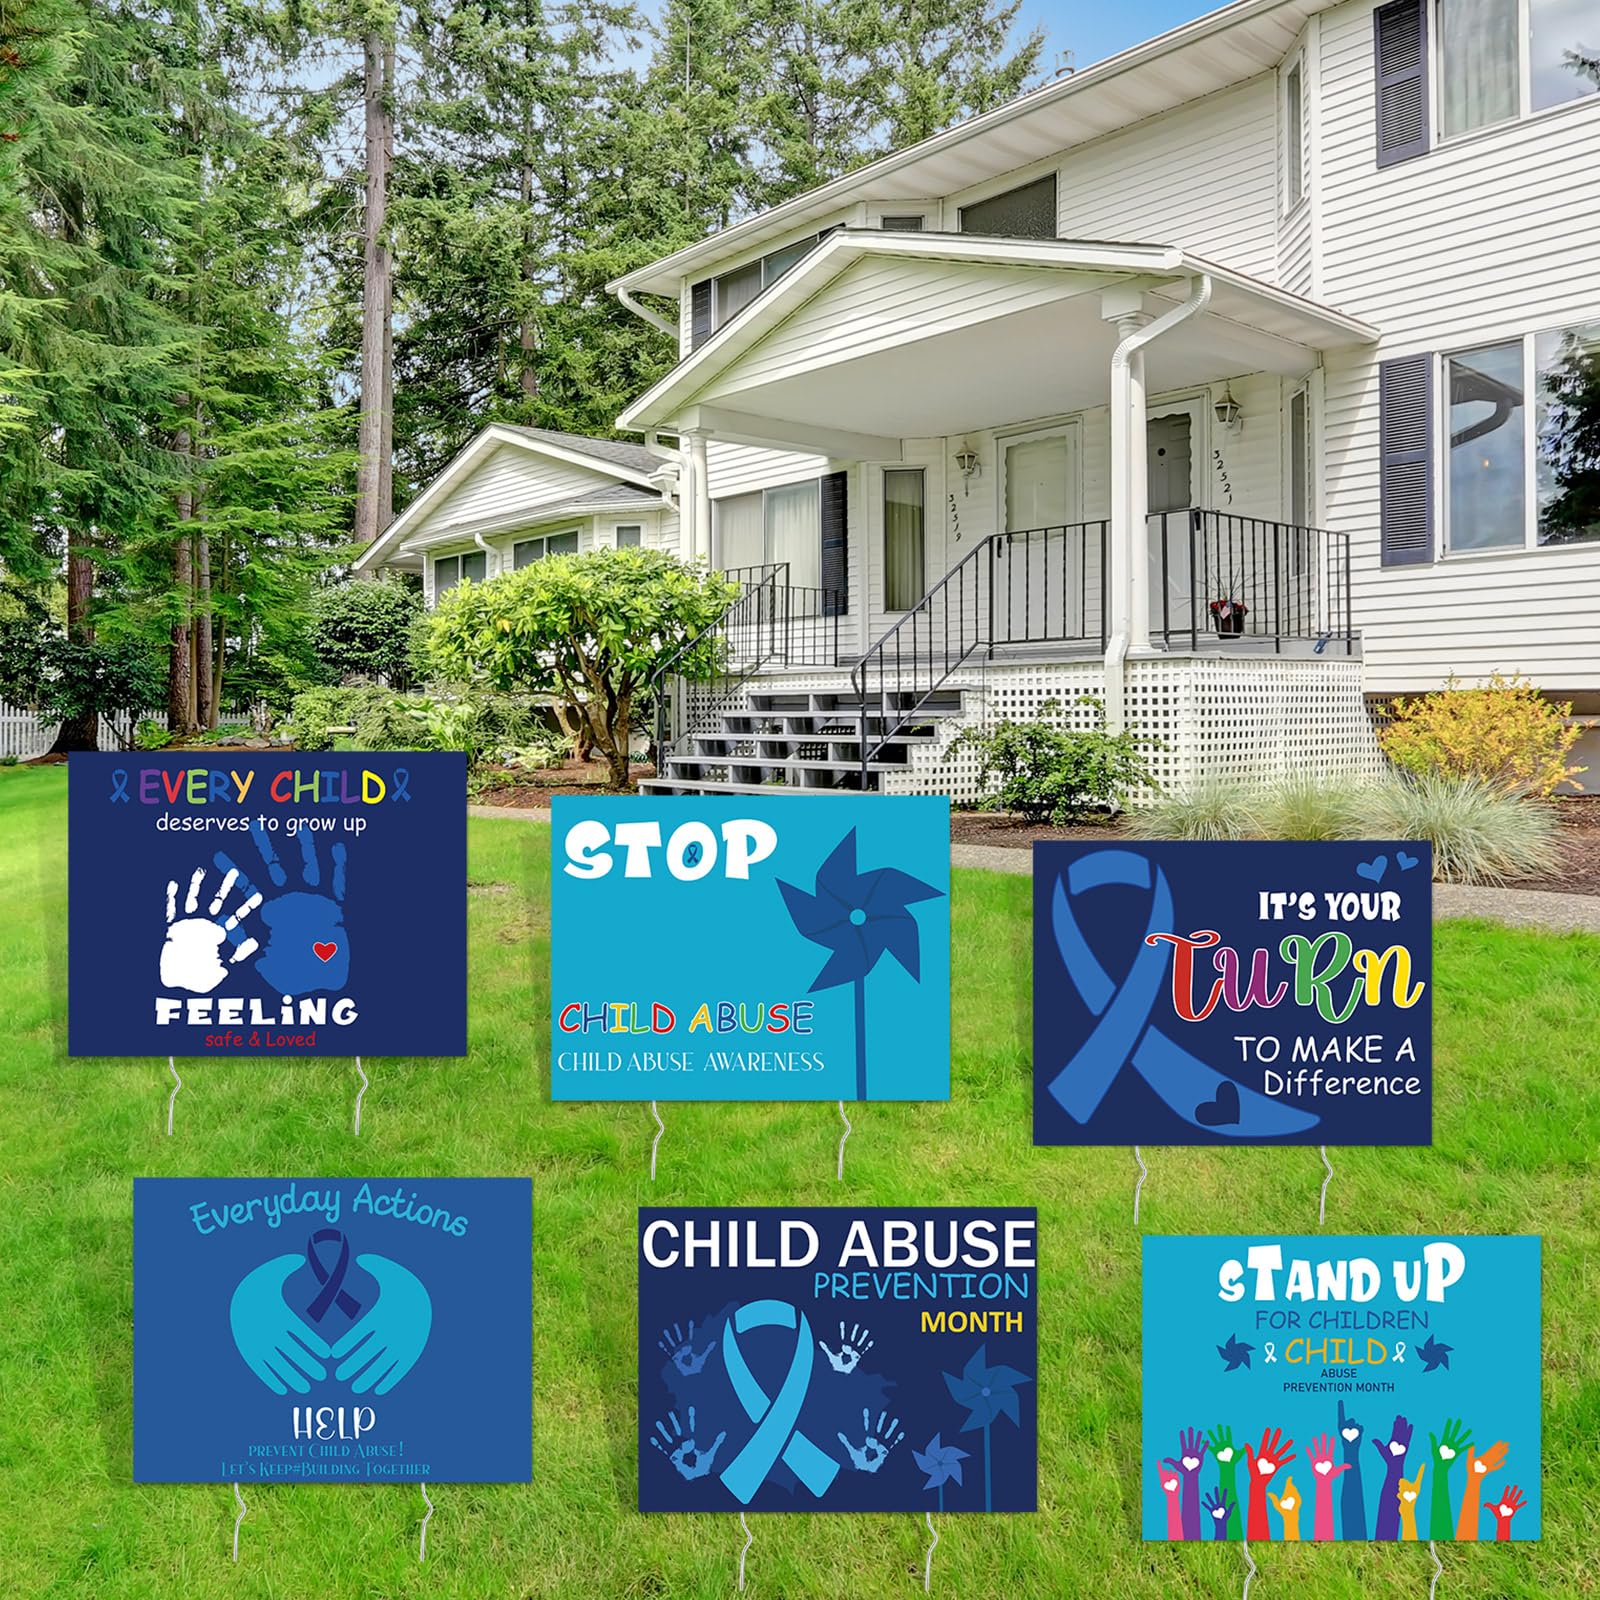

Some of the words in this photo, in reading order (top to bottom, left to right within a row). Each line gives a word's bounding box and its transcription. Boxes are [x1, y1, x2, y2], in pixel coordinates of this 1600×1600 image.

[140, 769, 255, 804] EVERY
[270, 770, 386, 804] CHILD
[156, 812, 250, 831] deserves
[257, 814, 278, 831] to
[286, 817, 336, 837] grow
[344, 817, 366, 836] up
[563, 819, 778, 881] STOP
[1259, 891, 1316, 920] IT'S
[1324, 892, 1401, 922] YOUR
[559, 1002, 676, 1034] CHILD
[689, 1002, 814, 1034] ABUSE
[205, 1031, 242, 1047] safe
[249, 1033, 260, 1046] &
[266, 1032, 316, 1047] Loved
[1234, 1037, 1280, 1062] TO
[1292, 1036, 1383, 1063] MAKE
[1395, 1037, 1416, 1062] A
[558, 1052, 622, 1071] CHILD
[627, 1052, 694, 1071] ABUSE
[704, 1052, 824, 1071] AWARENESS
[1264, 1070, 1421, 1096] Difference
[190, 1183, 340, 1235] Everyday
[353, 1183, 468, 1237] Actions
[642, 1219, 820, 1268] CHILD
[838, 1219, 1036, 1268] ABUSE
[814, 1272, 1028, 1299] PREVENTION
[921, 1311, 1023, 1332] MONTH
[1256, 1311, 1301, 1330] FOR
[1309, 1311, 1428, 1330] CHILDREN
[1285, 1338, 1387, 1364] CHILD
[1321, 1369, 1357, 1379] ABUSE
[1284, 1383, 1352, 1393] PREVENTION
[1356, 1383, 1394, 1393] MONTH
[293, 1406, 376, 1440] HELP
